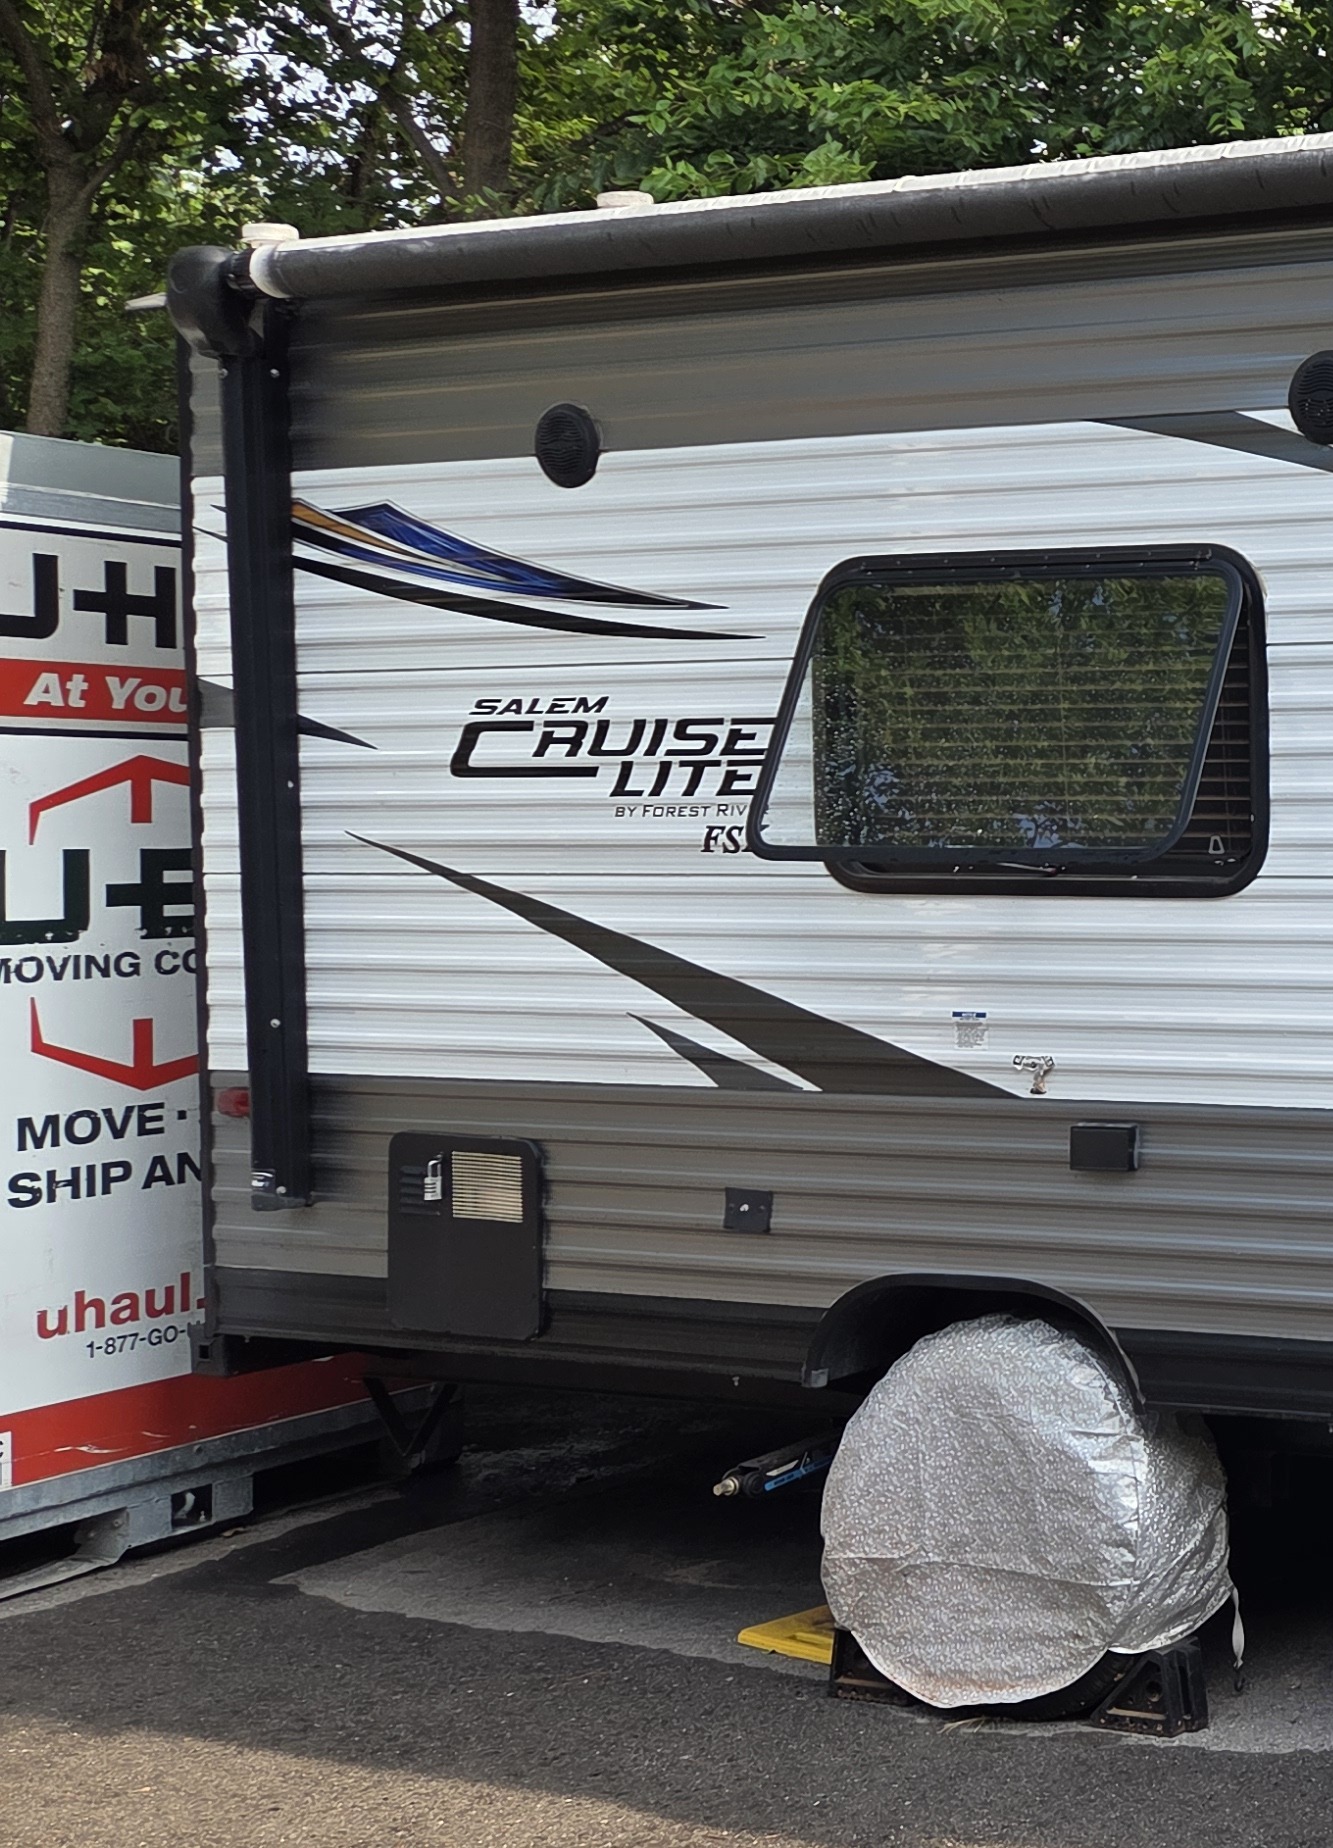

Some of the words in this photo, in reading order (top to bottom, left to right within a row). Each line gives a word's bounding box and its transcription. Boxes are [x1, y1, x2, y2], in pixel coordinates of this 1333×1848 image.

[24, 672, 89, 708] At
[468, 695, 609, 715] SALEM
[450, 717, 777, 778] CRUISE
[609, 758, 766, 797] LITE
[615, 805, 635, 818] BY
[642, 803, 711, 818] FOREST
[17, 1102, 165, 1151] MOVE
[8, 1160, 132, 1208] SHIP
